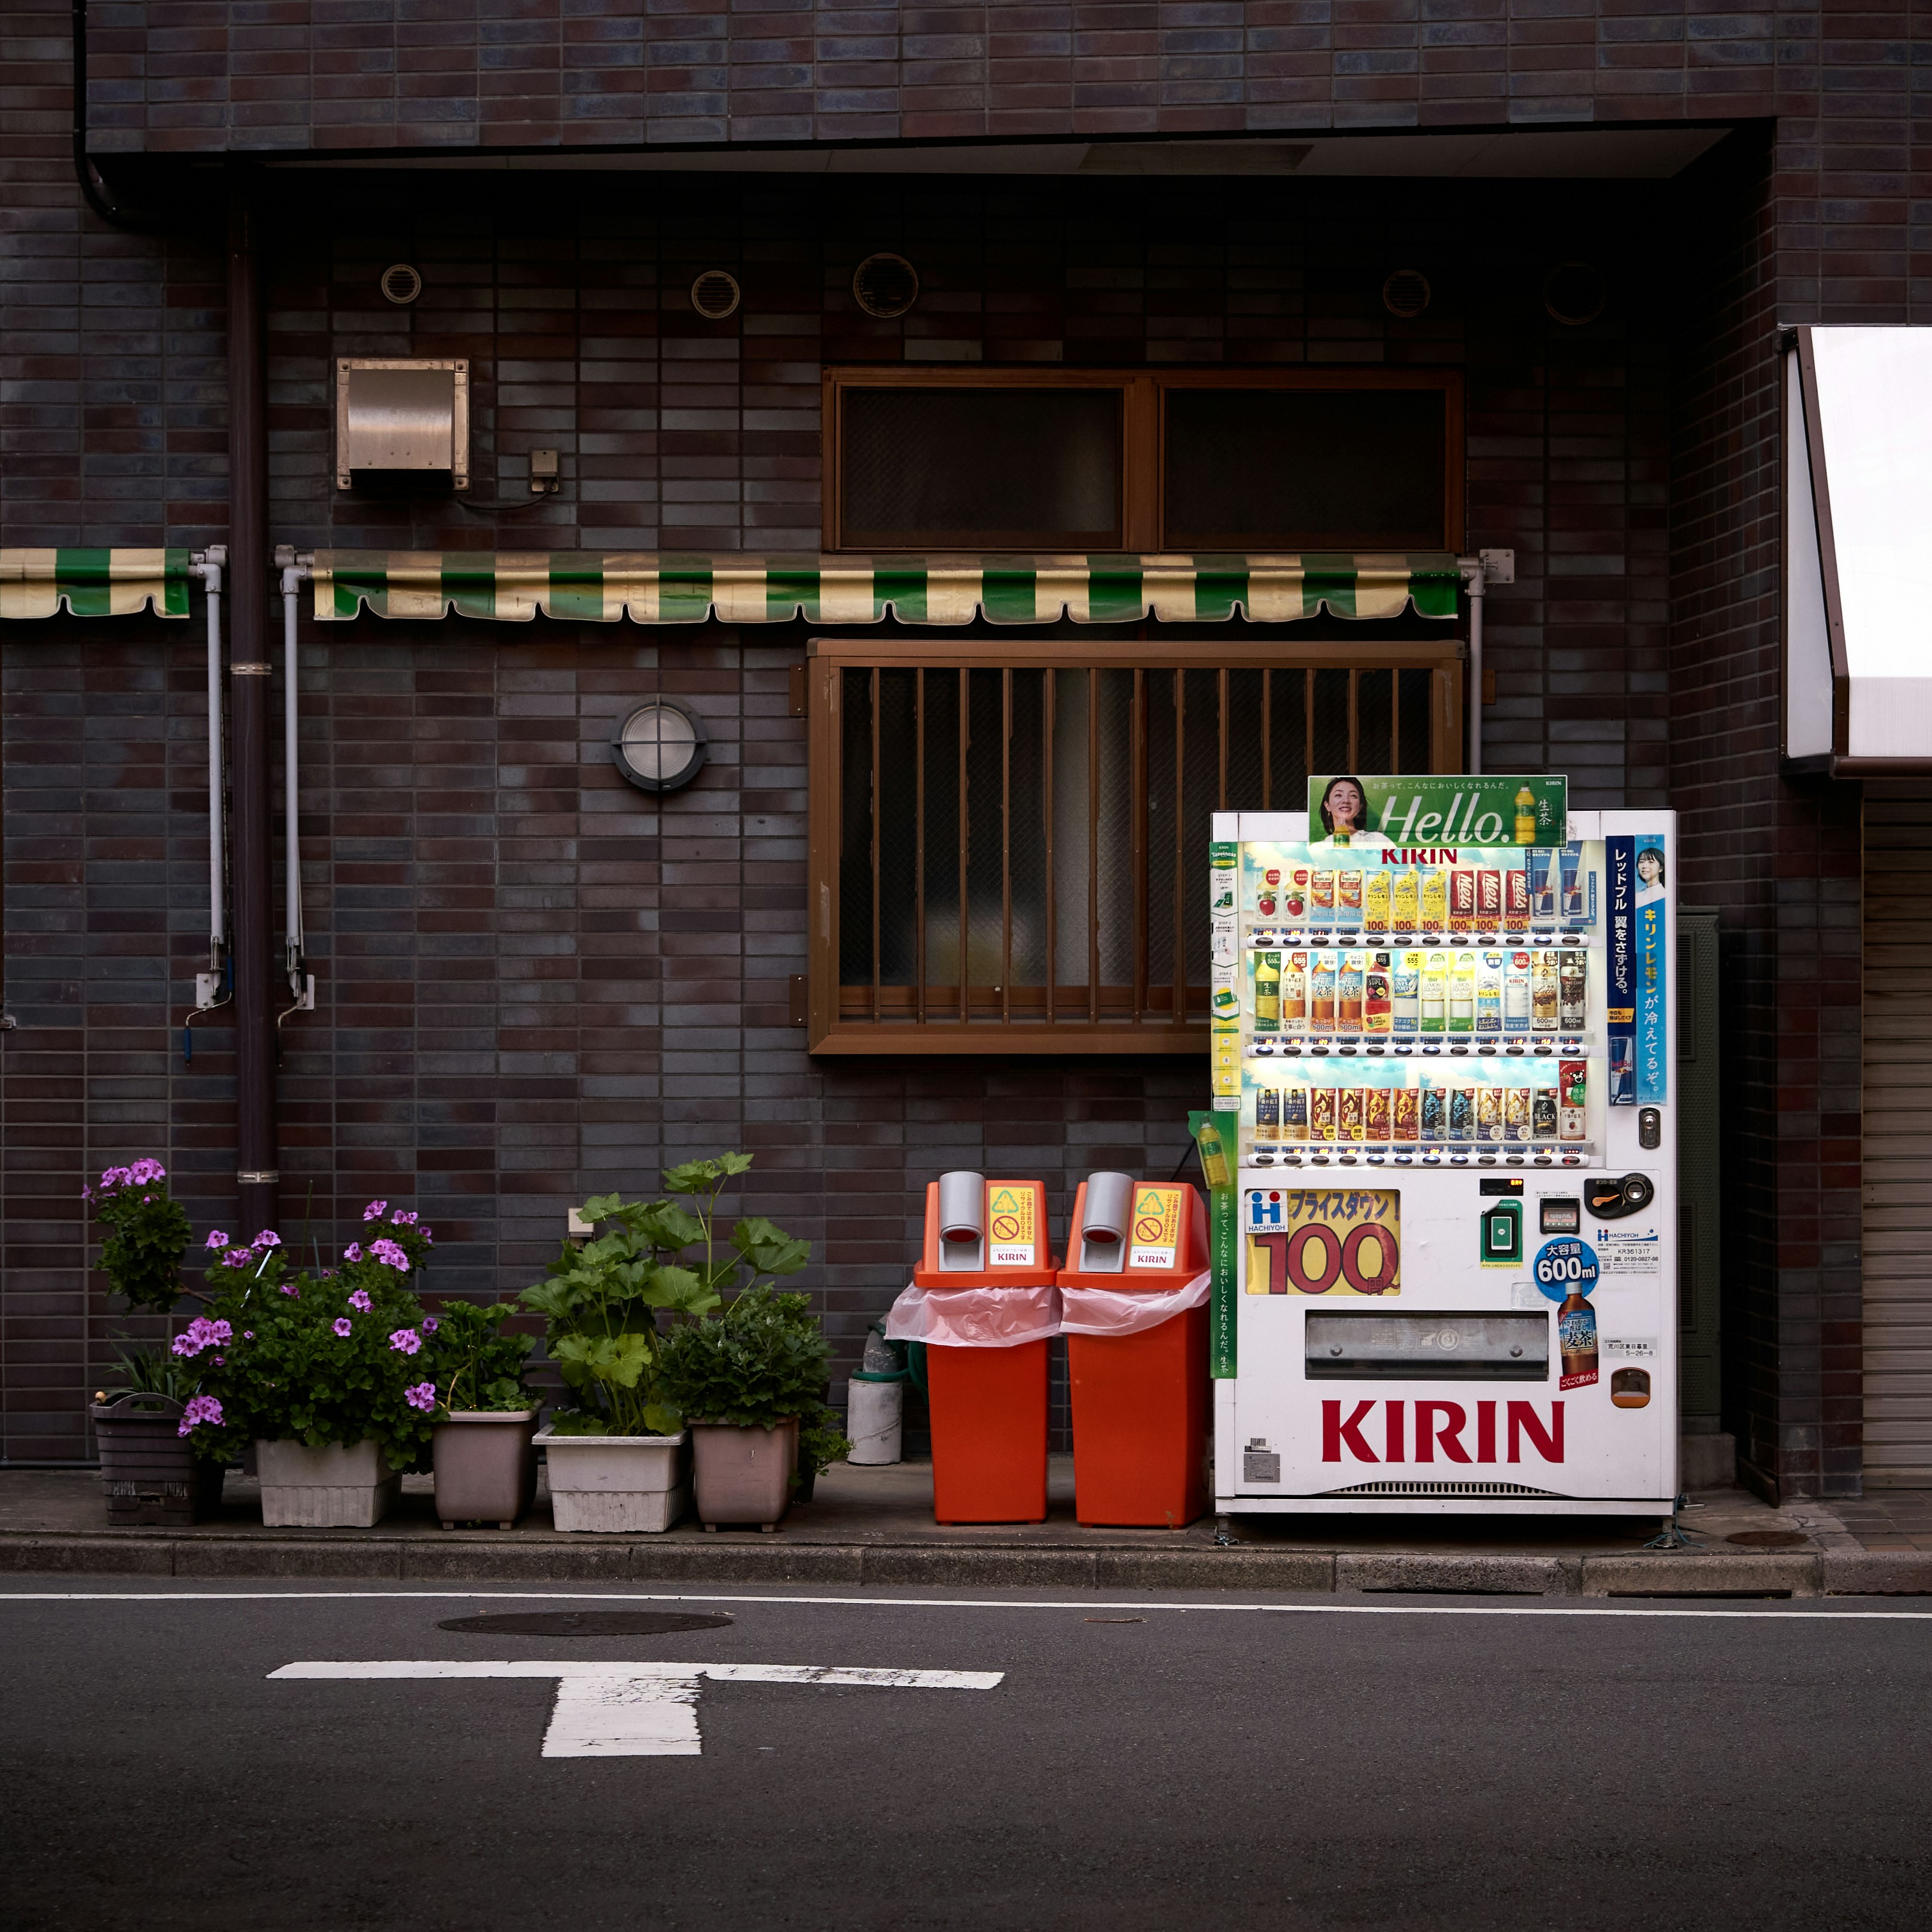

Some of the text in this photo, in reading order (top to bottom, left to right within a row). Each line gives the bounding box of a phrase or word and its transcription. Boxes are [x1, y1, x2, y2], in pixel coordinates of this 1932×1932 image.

[1373, 782, 1510, 790] お茶って、こんなにおいしくなれるんだ。
[1378, 792, 1510, 844] Hello.
[1538, 798, 1552, 826] 生茶
[1381, 849, 1457, 864] KIRIN
[1460, 873, 1472, 909] Mets
[1485, 873, 1498, 909] Mets
[1367, 921, 1388, 930] 100円
[1395, 921, 1416, 930] 100円
[1423, 921, 1443, 930] 100円
[1450, 921, 1471, 930] 100円
[1476, 921, 1497, 930] 100円
[1506, 921, 1527, 930] 100円
[1615, 849, 1628, 994] レッドブル 翼をさずける。
[1263, 982, 1271, 996] 生茶
[1316, 987, 1332, 996] 麦茶
[1342, 987, 1359, 996] 麦茶
[1644, 909, 1659, 1091] キリンレモンが冷えてるぞ。
[1290, 1189, 1400, 1221] プライスダウン!
[1163, 1194, 1172, 1243] リサイクルBOXです
[1169, 1194, 1179, 1243] ごみ箱ではありません
[1546, 1243, 1582, 1256] 大容量
[1138, 1255, 1167, 1263] KIRIN
[1220, 1193, 1229, 1353] お茶って、こんなにおいしくなれるんだ。
[1537, 1257, 1596, 1283] 600ml
[1565, 1330, 1592, 1348] 麦茶
[1561, 1372, 1598, 1387] ごくごく飲める
[1321, 1399, 1565, 1464] KIRIN
